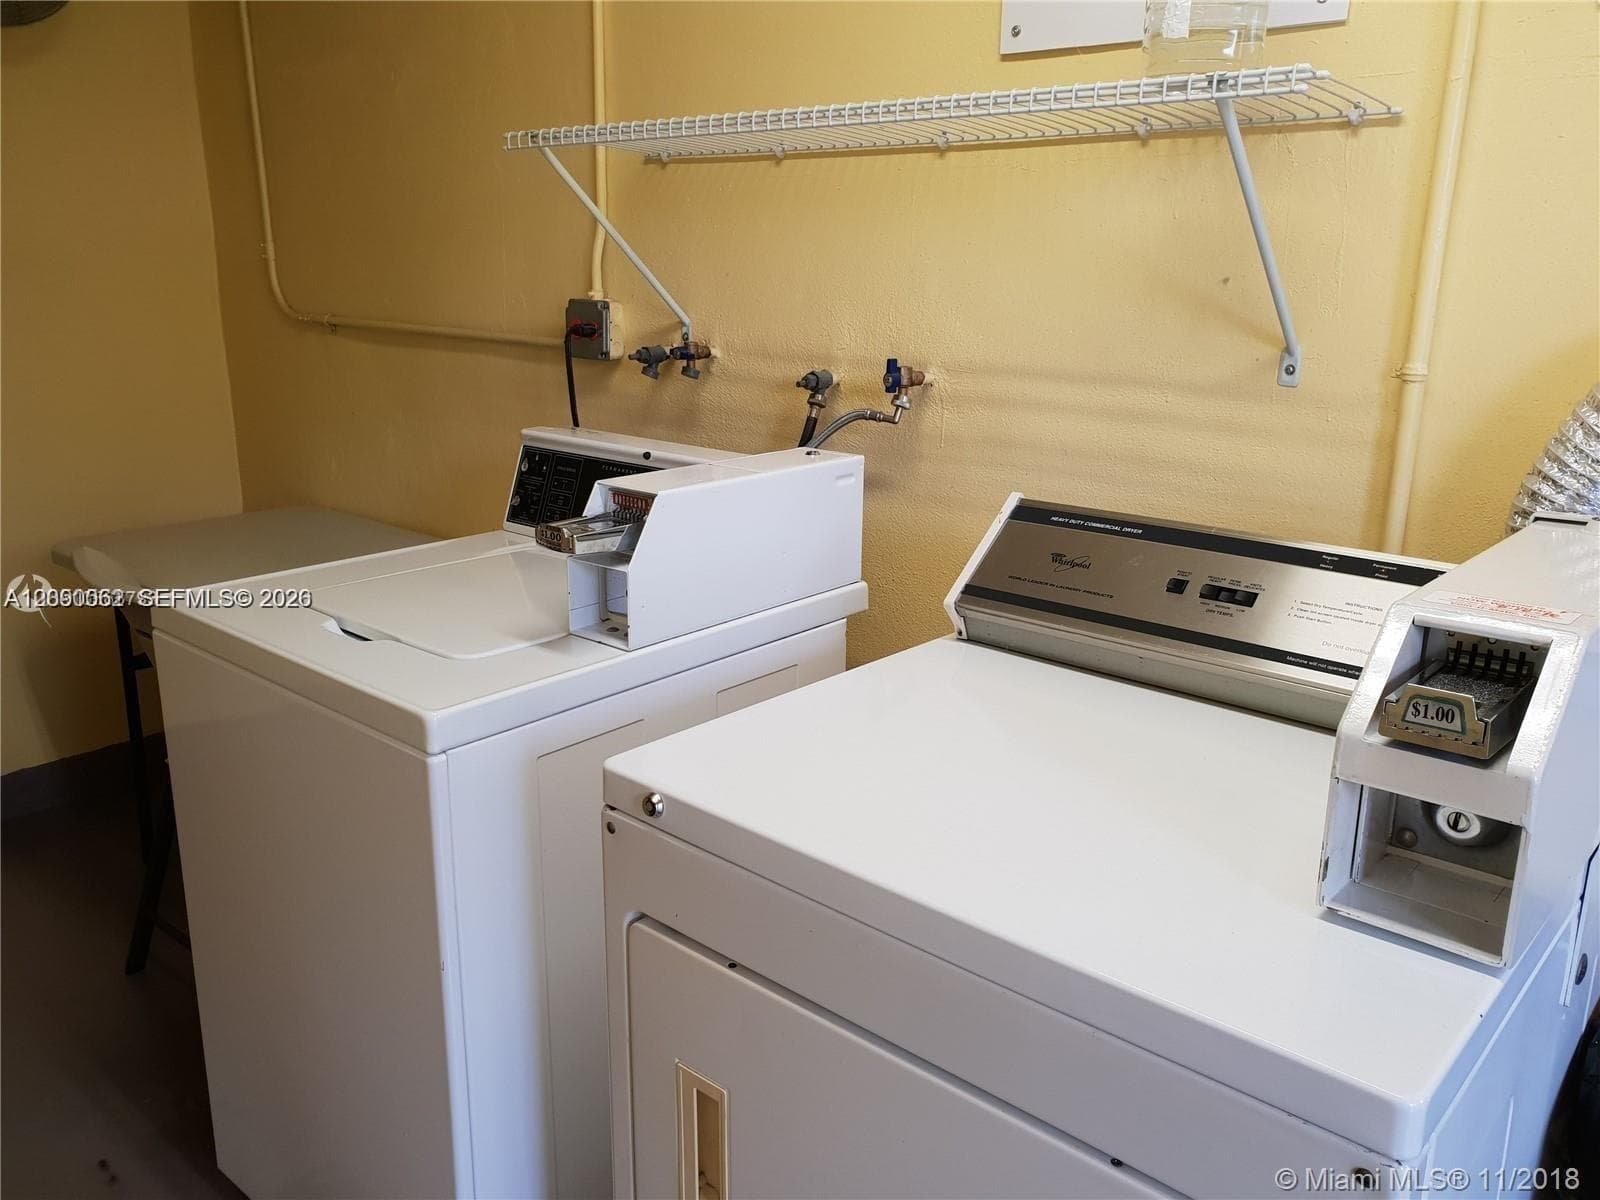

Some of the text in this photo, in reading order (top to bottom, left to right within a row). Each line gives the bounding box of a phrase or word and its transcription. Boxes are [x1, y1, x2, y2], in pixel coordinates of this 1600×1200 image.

[1084, 521, 1121, 531] COMMERCIAL
[1050, 554, 1092, 573] Whirlpool
[1082, 590, 1114, 599] PRODUCTS
[1286, 655, 1308, 664] Machine
[1327, 665, 1347, 673] operate
[1411, 700, 1455, 724] $1.00
